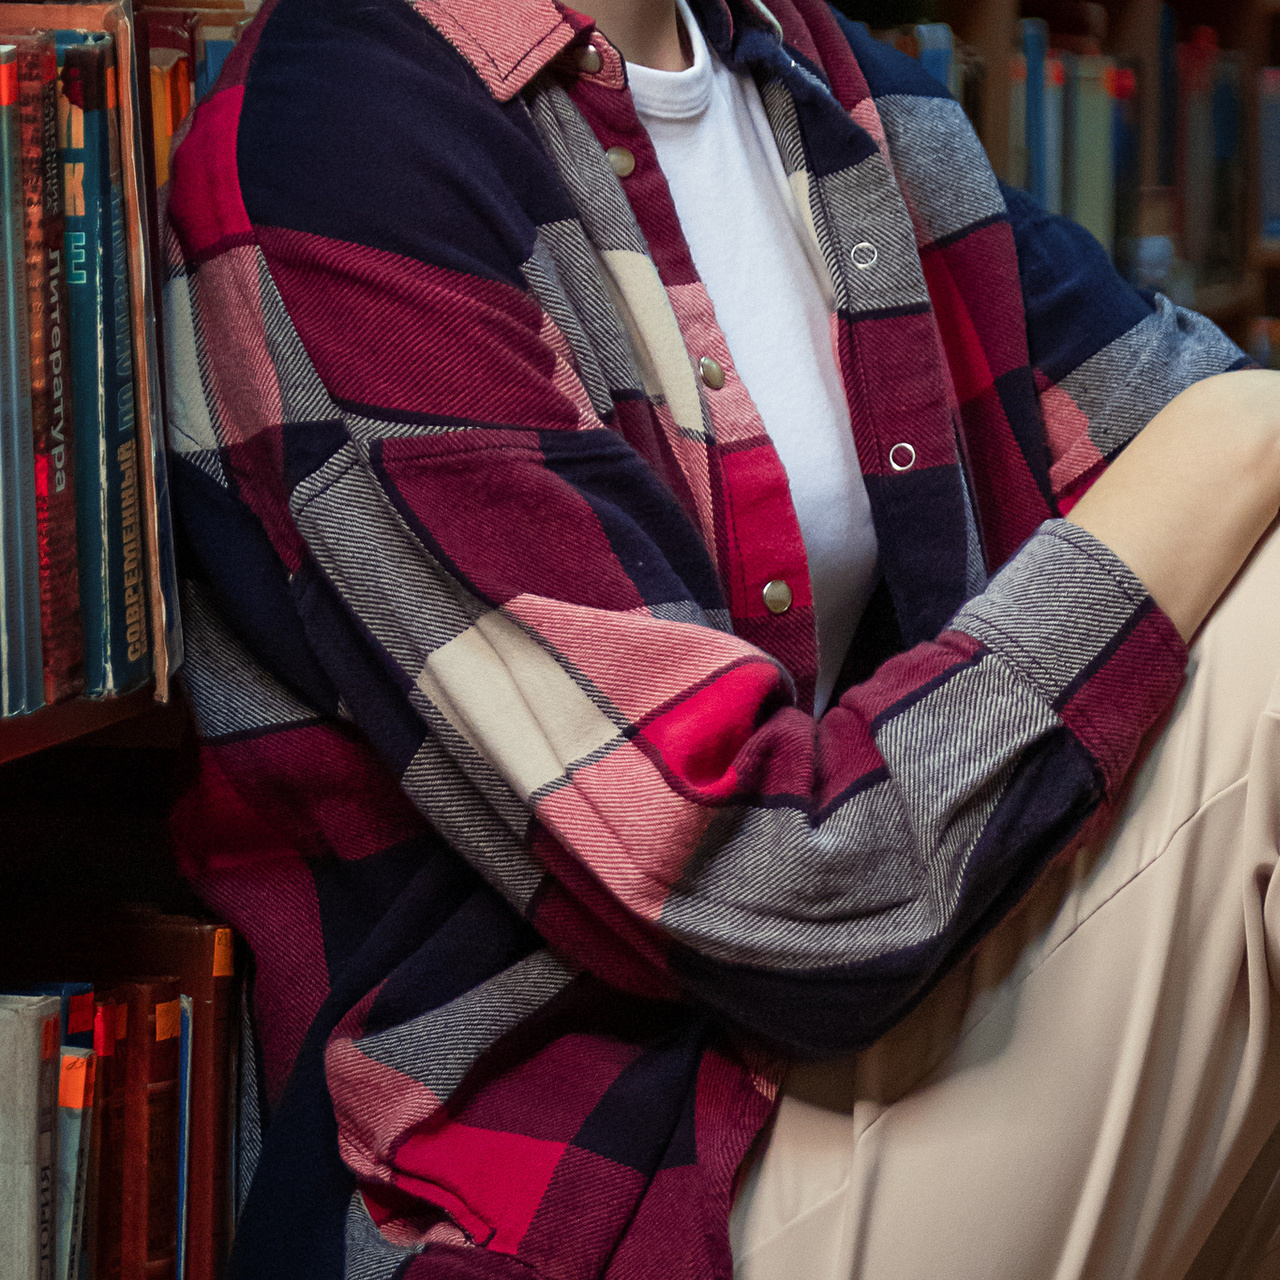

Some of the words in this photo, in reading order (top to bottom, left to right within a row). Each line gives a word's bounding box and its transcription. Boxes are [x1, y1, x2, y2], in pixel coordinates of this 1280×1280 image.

[49, 82, 58, 216] ПРАВОЧНИК
[48, 247, 67, 494] Литература
[117, 441, 141, 662] СОВРЕМЕННЫЙ
